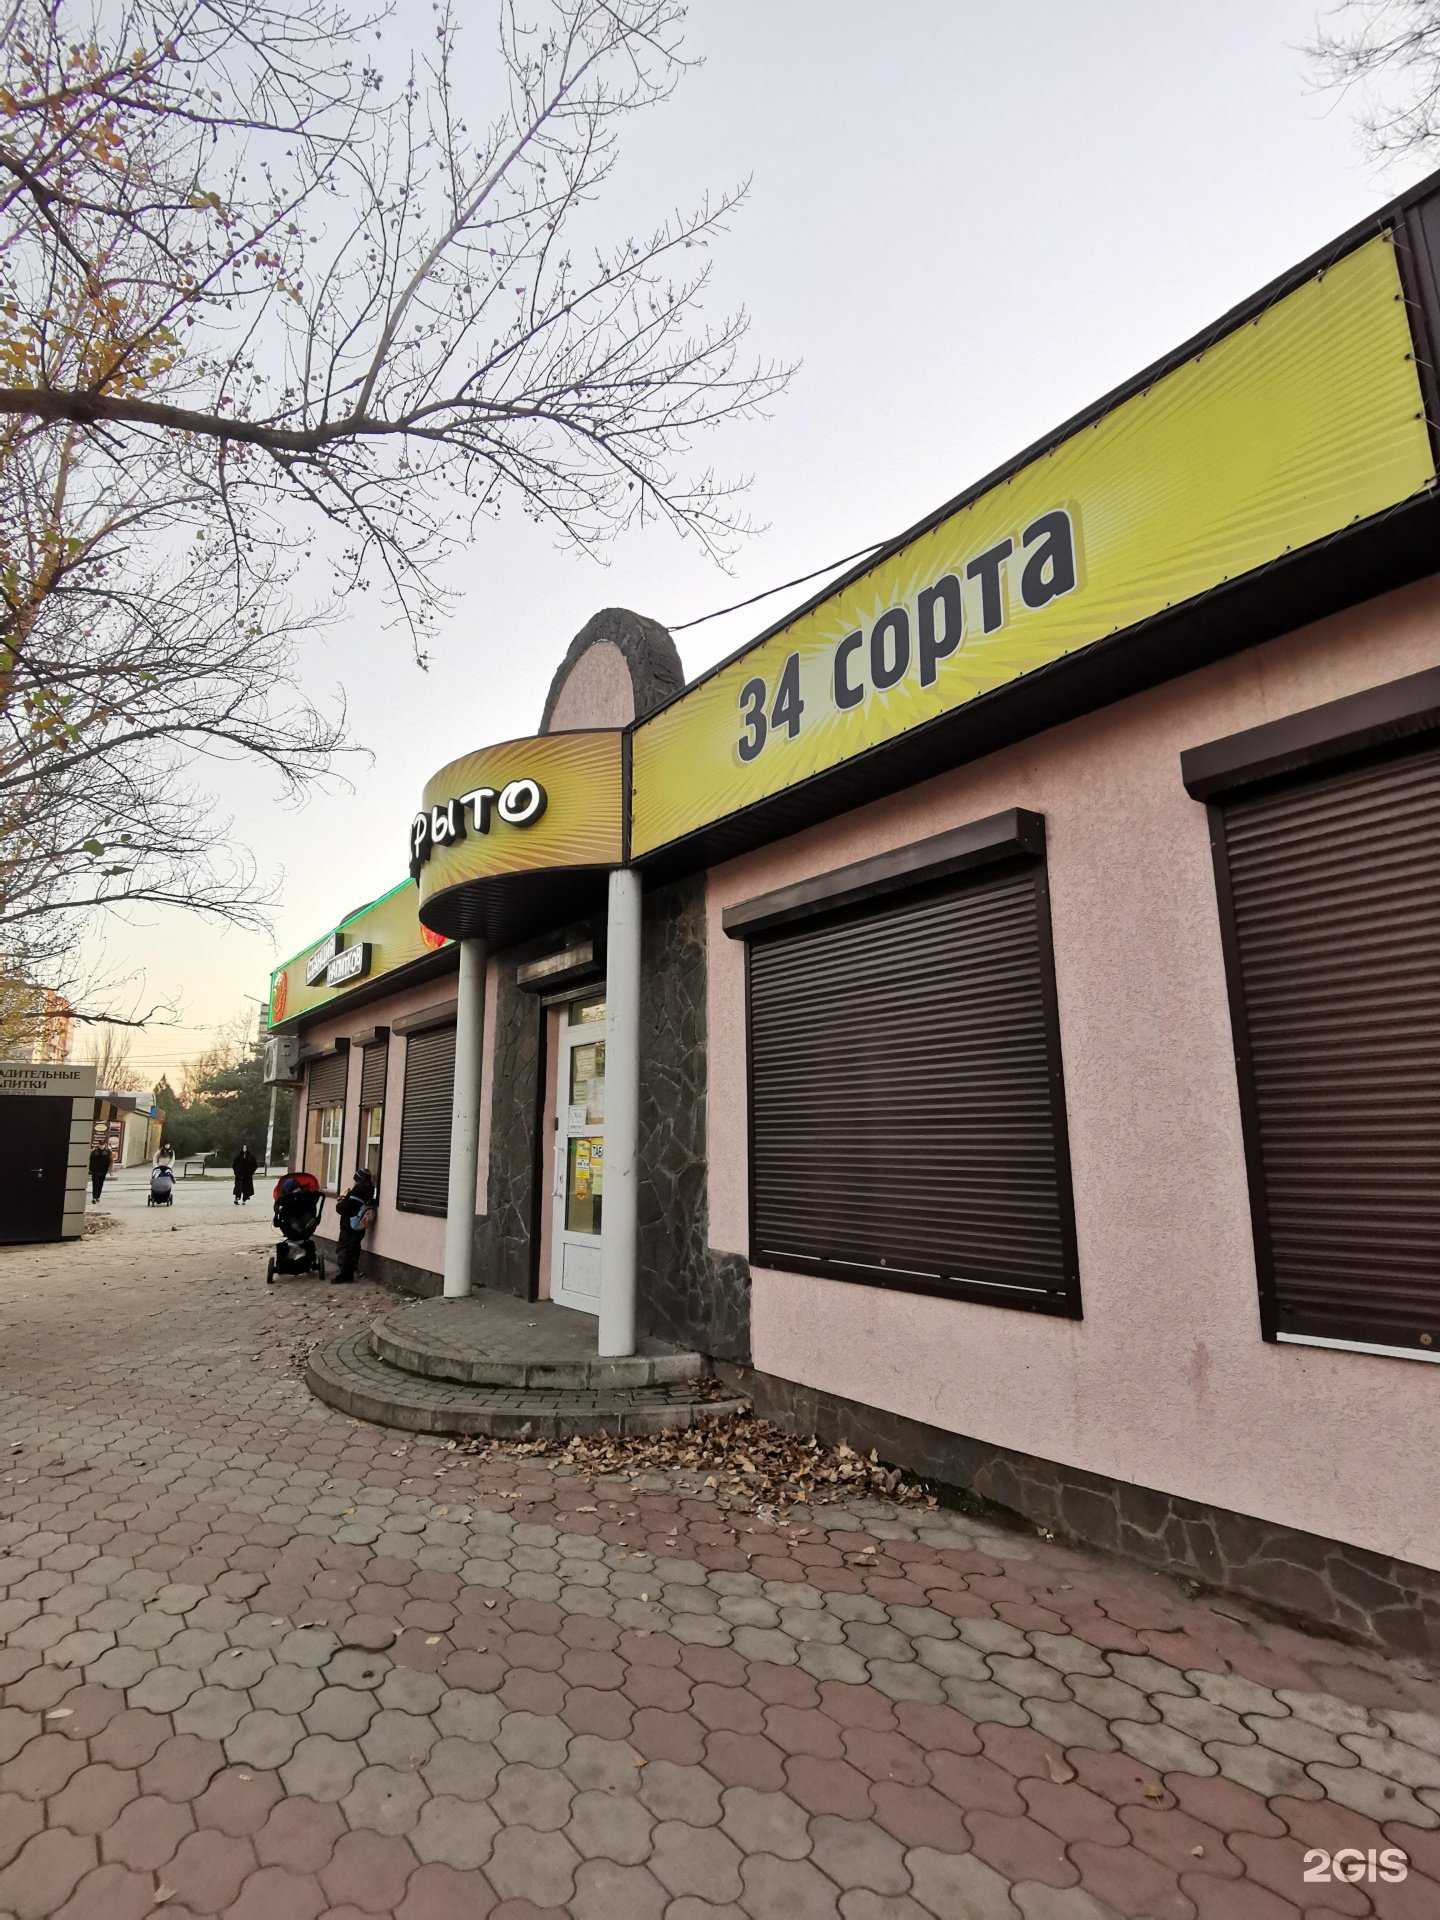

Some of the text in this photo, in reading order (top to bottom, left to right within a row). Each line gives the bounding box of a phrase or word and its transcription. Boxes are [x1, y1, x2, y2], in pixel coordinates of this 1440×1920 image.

[738, 509, 1076, 762] 34 сорта
[408, 778, 546, 866] РЫТО
